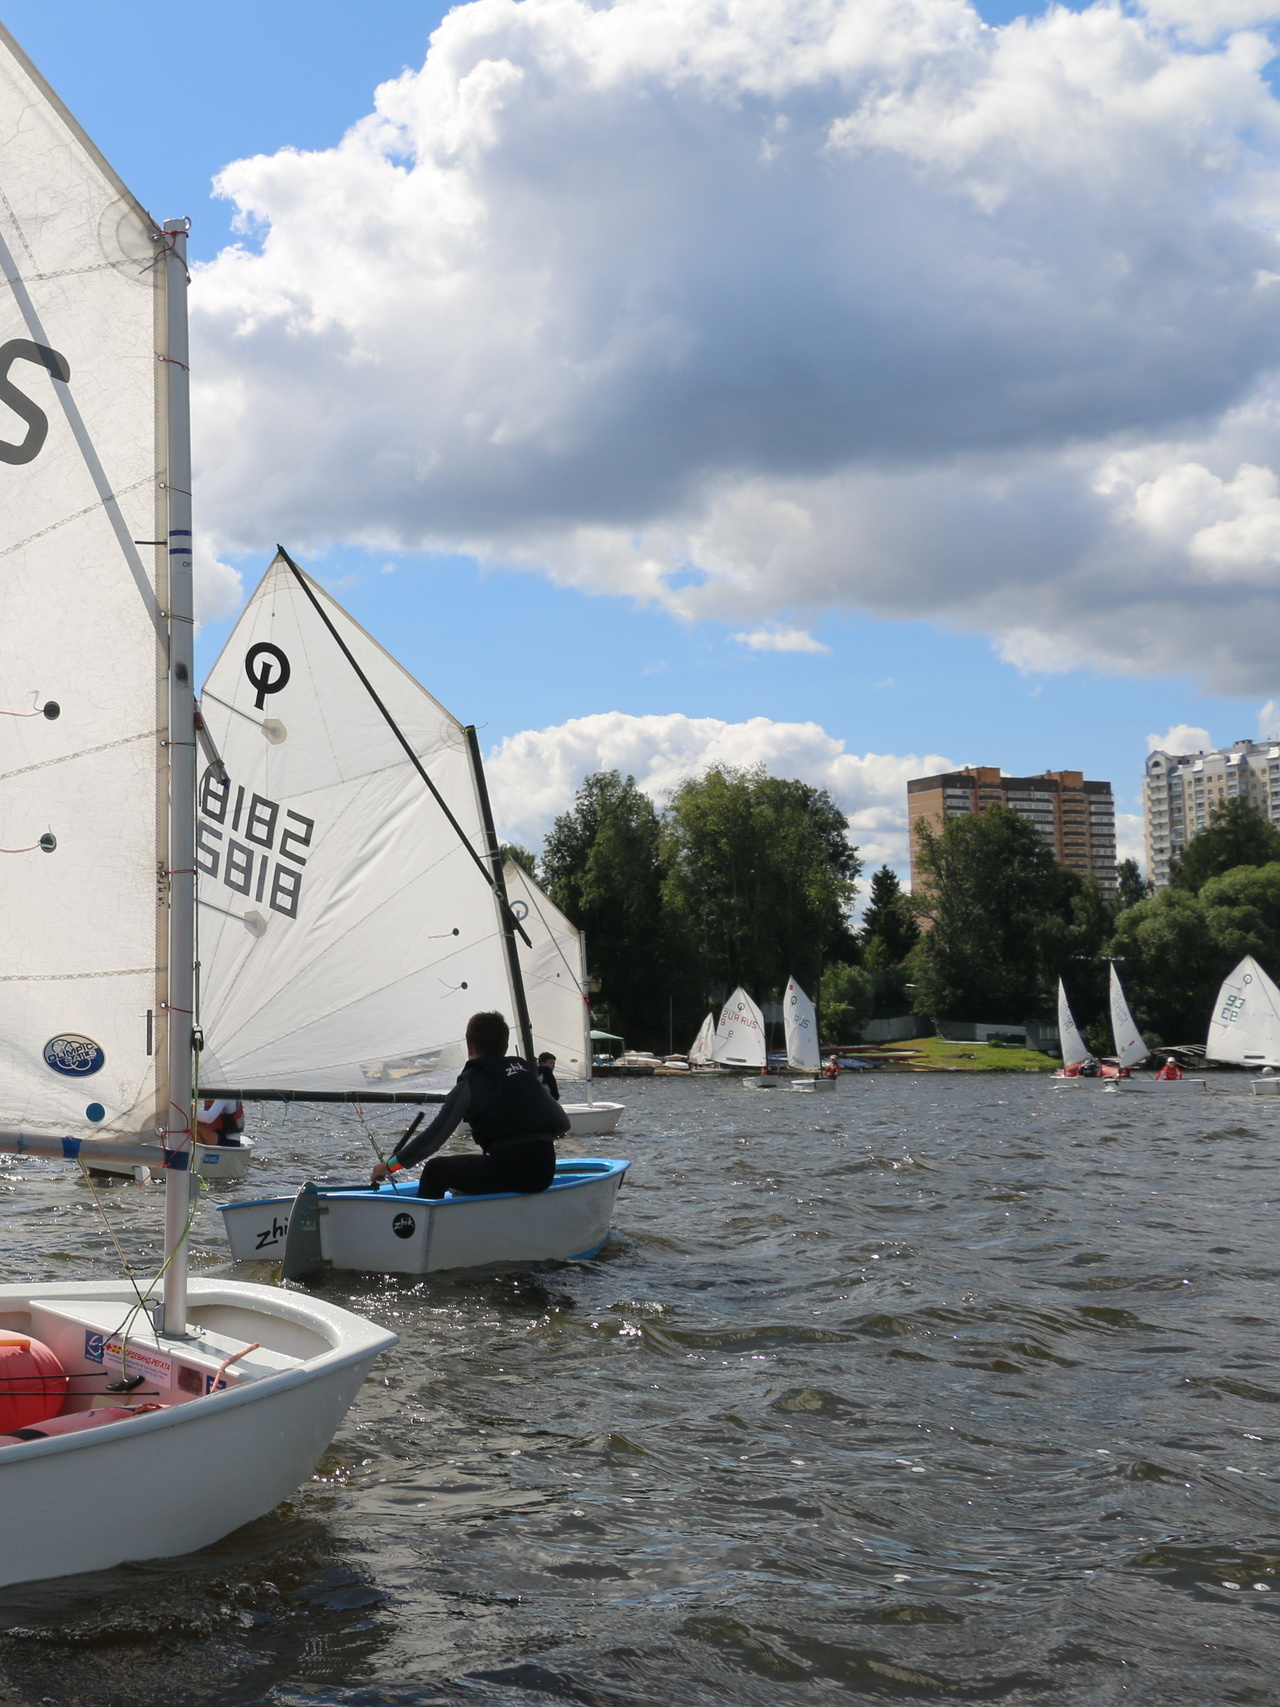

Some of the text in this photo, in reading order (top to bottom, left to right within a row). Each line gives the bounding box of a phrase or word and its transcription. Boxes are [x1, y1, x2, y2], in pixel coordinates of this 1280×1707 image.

[740, 1016, 758, 1029] RUS
[48, 1043, 95, 1062] OLIMPIC
[65, 1049, 97, 1065] SAILS
[506, 1062, 529, 1077] zhik
[393, 1216, 415, 1231] zhik
[255, 1217, 289, 1250] zhi
